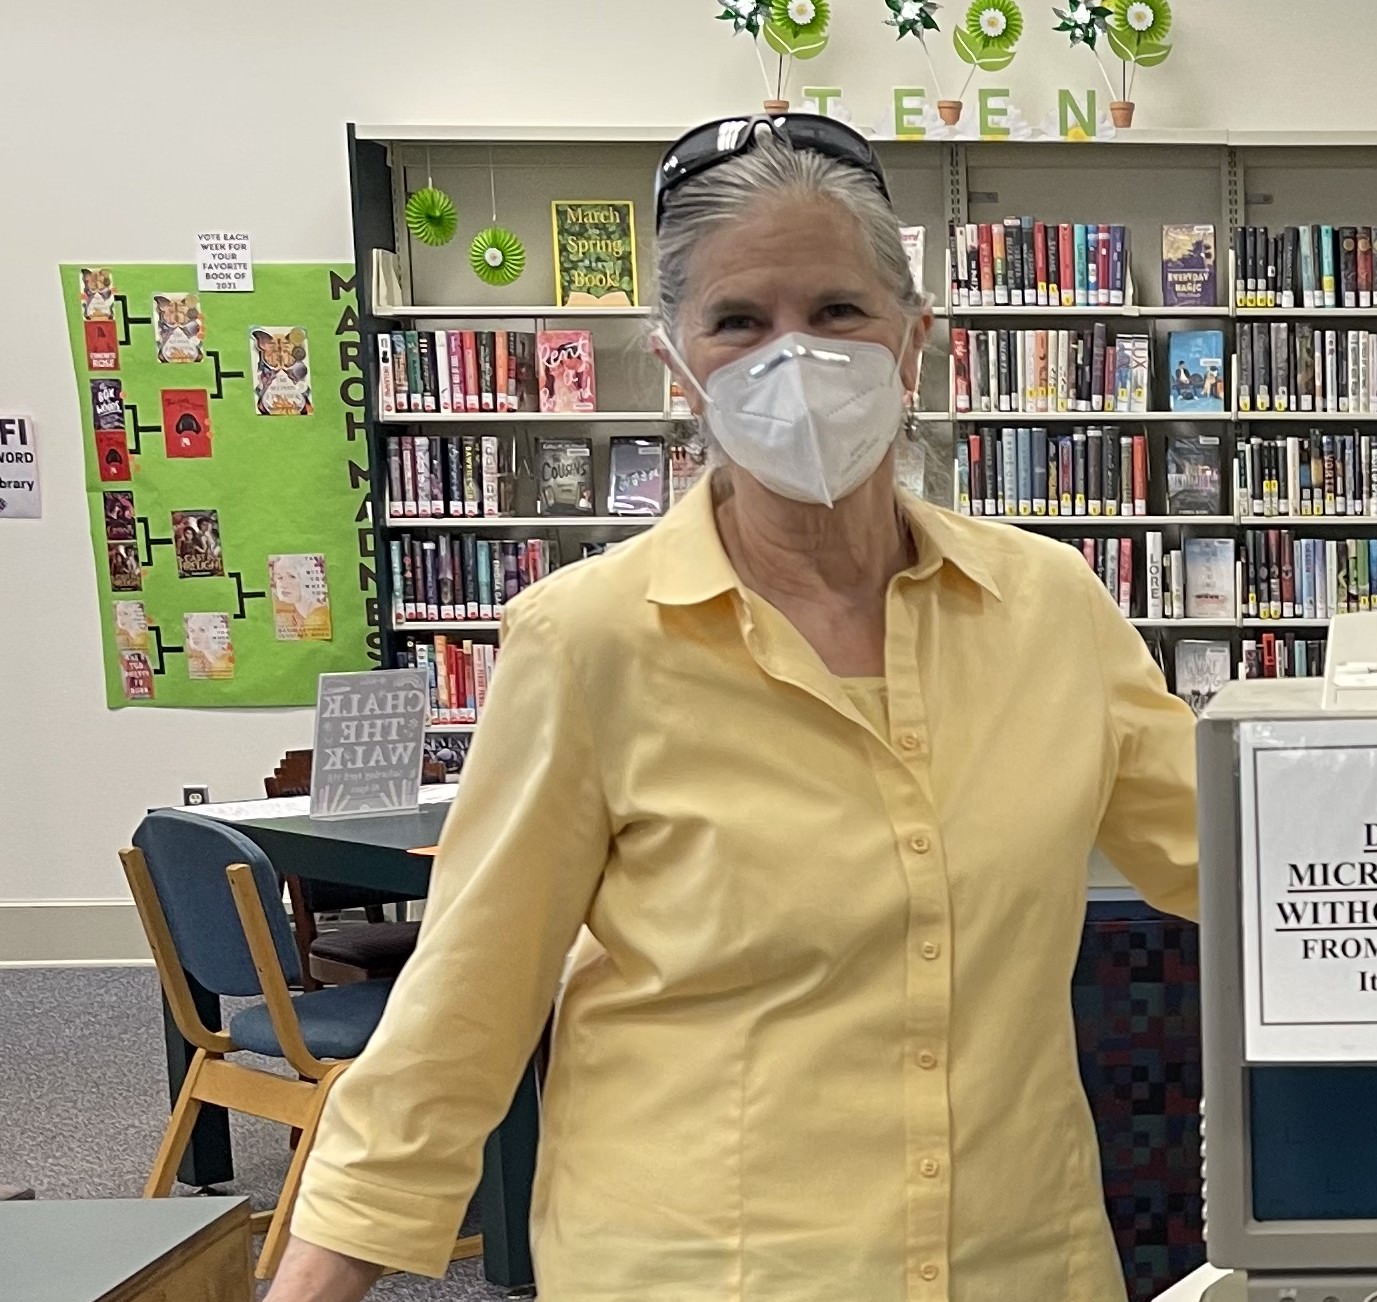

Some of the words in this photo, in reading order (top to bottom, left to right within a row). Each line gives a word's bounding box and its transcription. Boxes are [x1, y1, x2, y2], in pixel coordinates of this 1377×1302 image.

[566, 206, 621, 223] March
[198, 233, 221, 241] VOTE
[223, 233, 249, 241] EACH
[200, 243, 226, 251] WEEK
[228, 243, 247, 251] FOR
[566, 236, 622, 258] Spring
[211, 252, 238, 260] YOUR
[202, 262, 248, 270] FAVORITE
[205, 272, 232, 280] BOOK
[233, 272, 247, 280] OF
[1149, 553, 1160, 600] LORE
